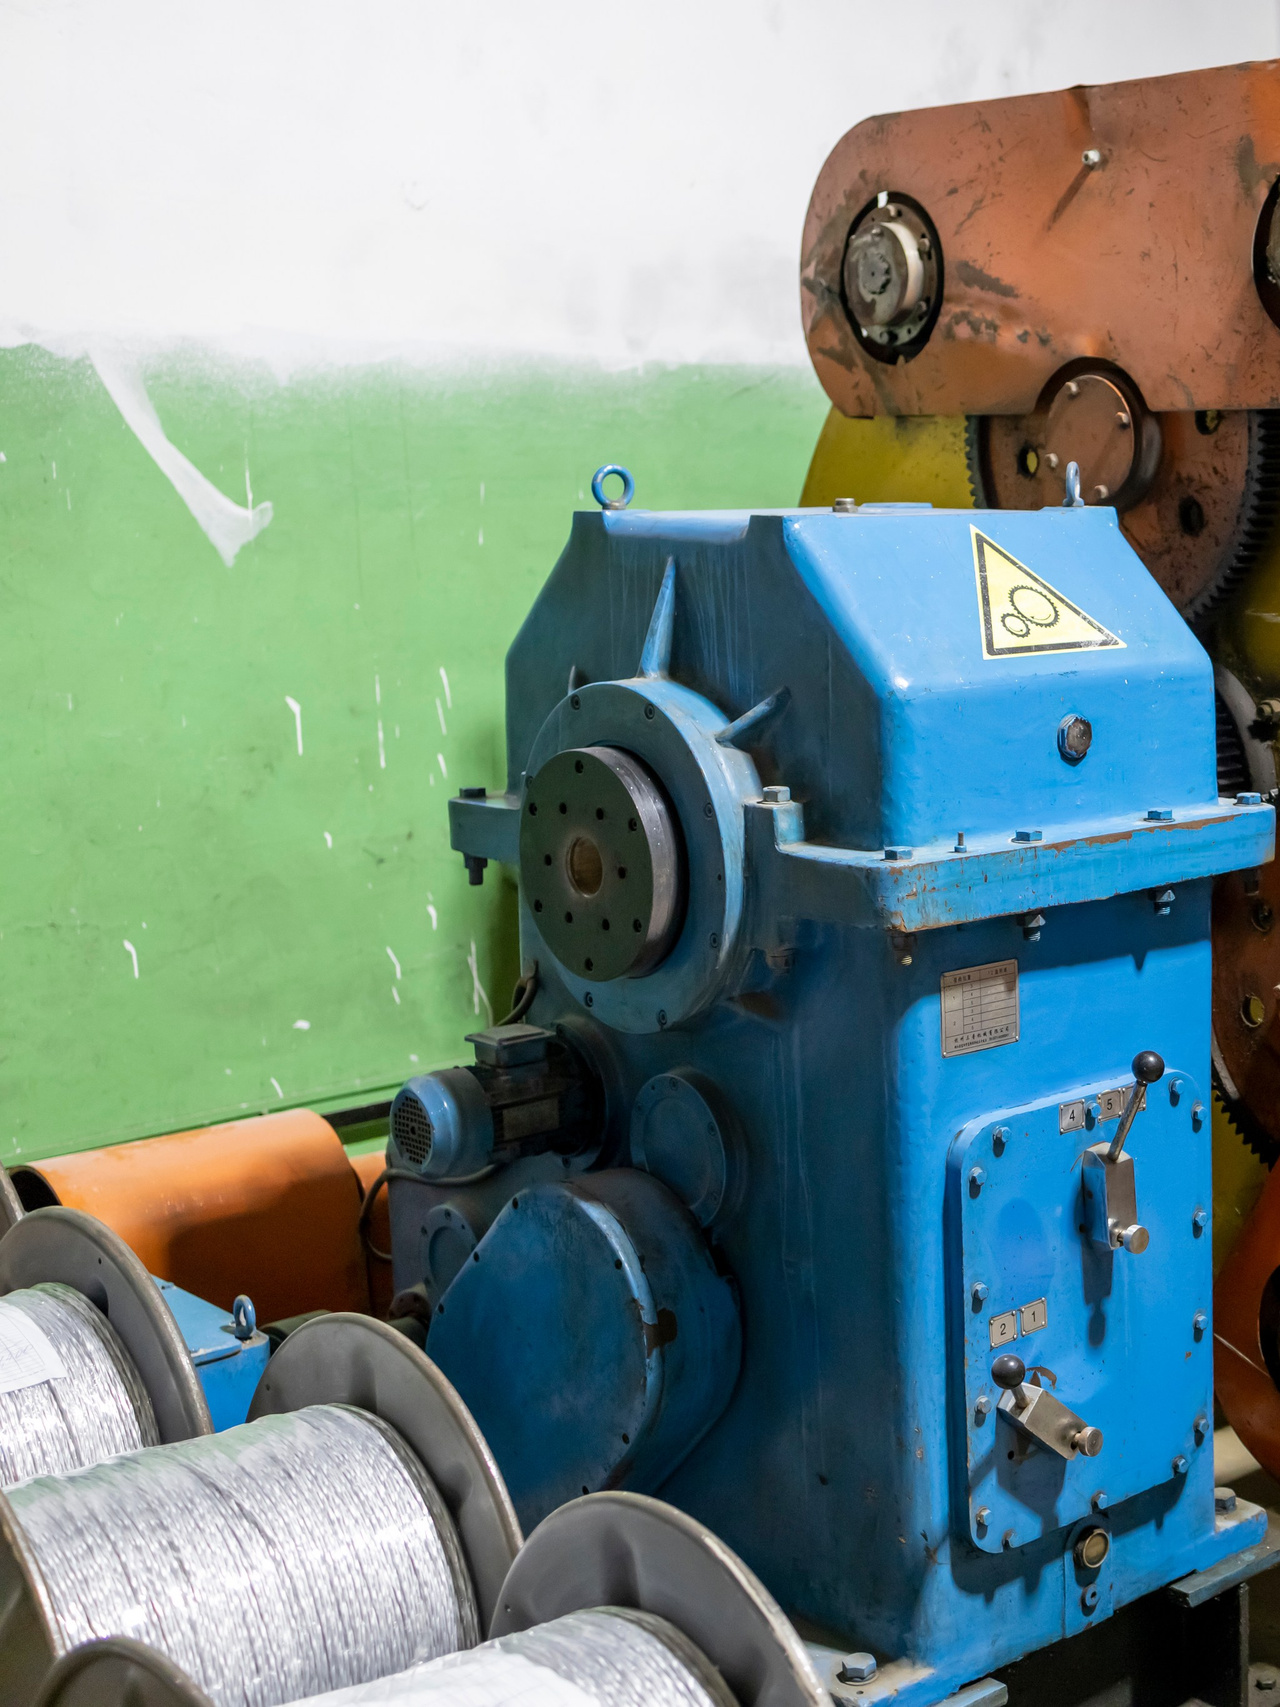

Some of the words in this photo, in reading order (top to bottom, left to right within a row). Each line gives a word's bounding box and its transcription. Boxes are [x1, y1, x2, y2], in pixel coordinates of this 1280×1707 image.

[1106, 1098, 1113, 1111] 5
[1069, 1109, 1076, 1122] 4
[1000, 1323, 1006, 1336] 2
